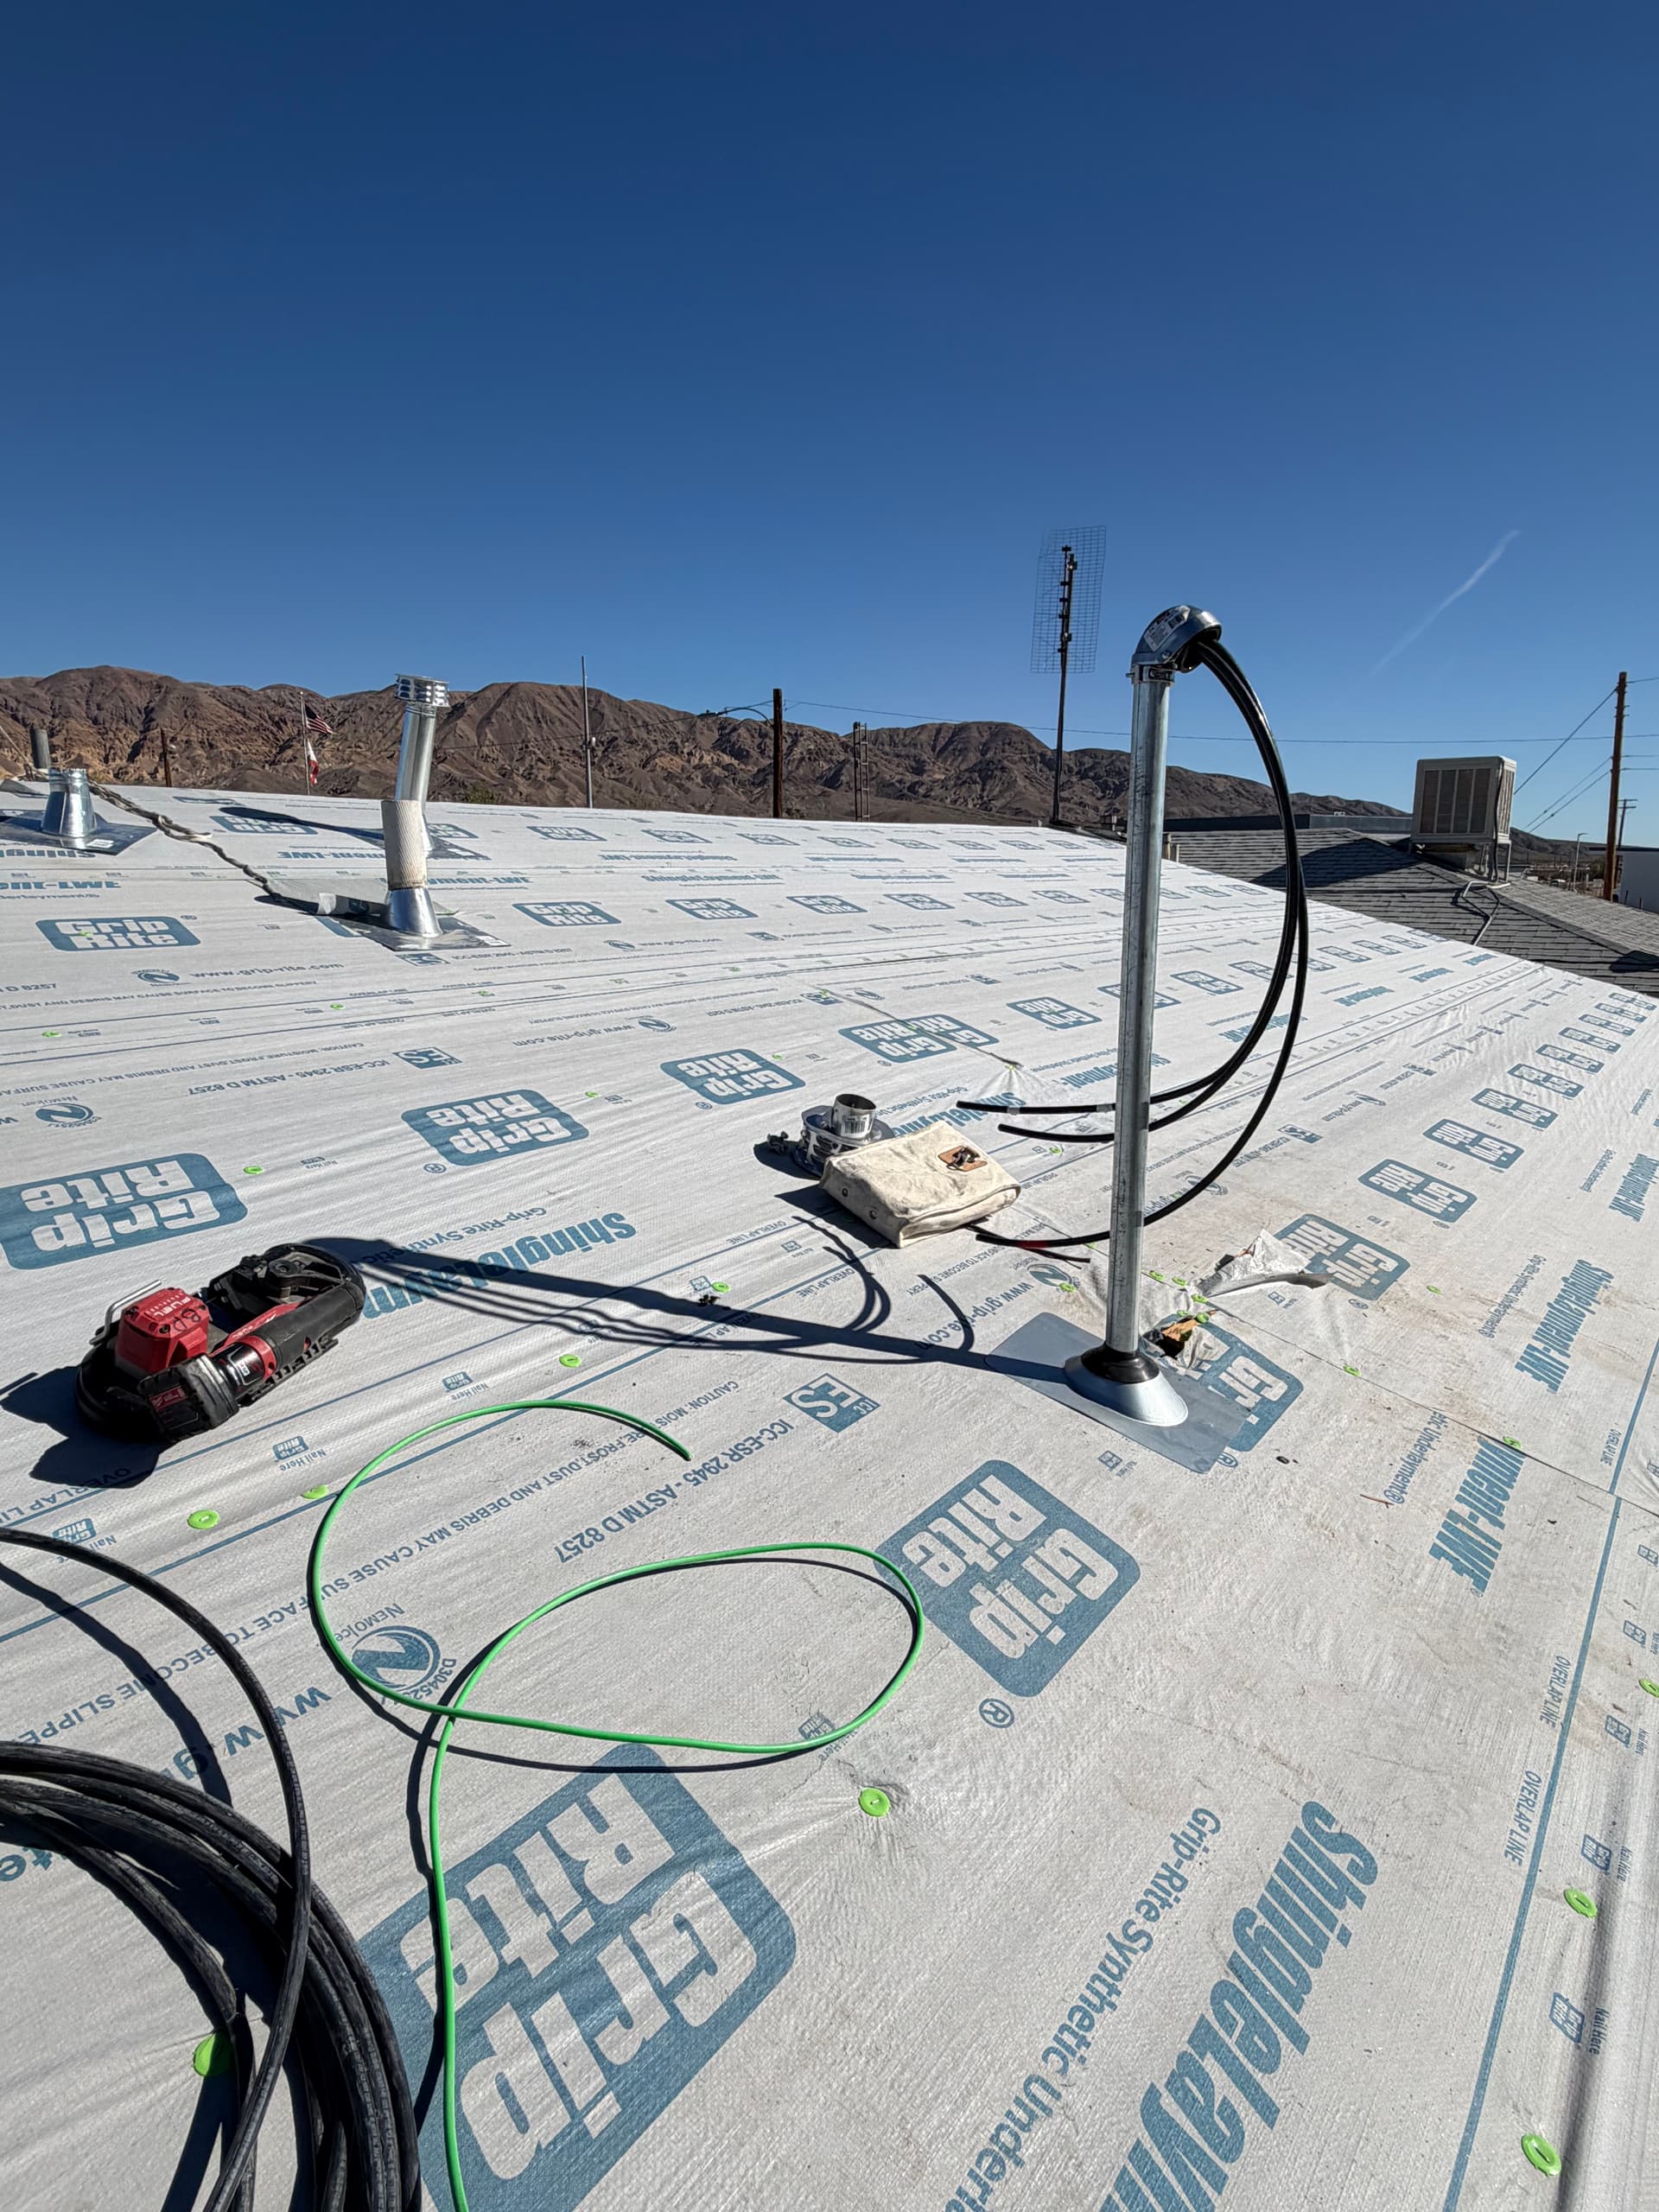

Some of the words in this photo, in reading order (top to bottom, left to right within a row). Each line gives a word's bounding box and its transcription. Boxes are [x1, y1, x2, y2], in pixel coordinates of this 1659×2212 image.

[526, 904, 593, 915] Grip
[543, 914, 609, 925] Rite
[55, 918, 169, 935] Grip
[69, 933, 179, 949] Rite
[190, 963, 345, 977] www.grip-rite.com
[850, 1021, 917, 1042] Rite
[397, 1046, 449, 1065] ES
[877, 1037, 947, 1058] Grip
[331, 1058, 391, 1073] ICC-ESR
[677, 1052, 762, 1078] Rite
[49, 1078, 96, 1090] CAUSE
[188, 1084, 226, 1096] 8257
[226, 1080, 241, 1090] D
[239, 1072, 286, 1088] ASTM
[703, 1070, 792, 1097] Grip
[426, 1094, 541, 1128] Rite
[449, 1117, 572, 1155] Grip
[1432, 1122, 1478, 1146] Rite
[1468, 1135, 1516, 1163] Grip
[423, 1163, 447, 1174] ®
[1369, 1163, 1425, 1194] Rite
[21, 1160, 194, 1212] Rite
[1407, 1182, 1468, 1216] Grip
[30, 1191, 220, 1253] Grip
[461, 1206, 548, 1236] Grip-Rite
[749, 1220, 787, 1237] OVERLAP
[726, 1232, 749, 1245] LINE
[362, 1212, 637, 1319] ShingleLaym
[1321, 1243, 1399, 1288] Grip
[154, 1298, 191, 1316] FUEL
[684, 1381, 741, 1411] CAUTION:
[790, 1373, 862, 1418] ES
[852, 1398, 878, 1415] ICC
[725, 1418, 795, 1463] ICC-ESR
[278, 1457, 304, 1472] Here
[305, 1448, 327, 1463] Nail
[682, 1455, 729, 1487] 2945
[508, 1484, 543, 1508] AND
[624, 1483, 678, 1525] ASTM
[449, 1497, 512, 1533] DEBRIS
[601, 1515, 626, 1535] D
[413, 1525, 453, 1551] MAY
[553, 1527, 606, 1564] 8257
[901, 1474, 1048, 1588] Rite
[348, 1545, 416, 1583] CAUSE
[252, 1577, 350, 1634] SUFACE
[969, 1528, 1119, 1660] Grip
[1546, 1655, 1572, 1702] OVERLAP
[12, 1694, 116, 1746] SLIPPE
[978, 1698, 1015, 1730] ®
[1540, 1698, 1554, 1728] LINE
[1513, 1770, 1542, 1834] OVERLAP
[1503, 1827, 1521, 1866] LINE
[1135, 1807, 1222, 1924] Grip-Rite
[399, 1773, 676, 2013] Rite
[1042, 1918, 1154, 2076] Synthetic
[1551, 1997, 1568, 2026] Rite
[460, 1870, 757, 2179] Grip
[1563, 2011, 1582, 2037] Grip
[1594, 2006, 1611, 2034] Nail
[1588, 2030, 1603, 2056] Here
